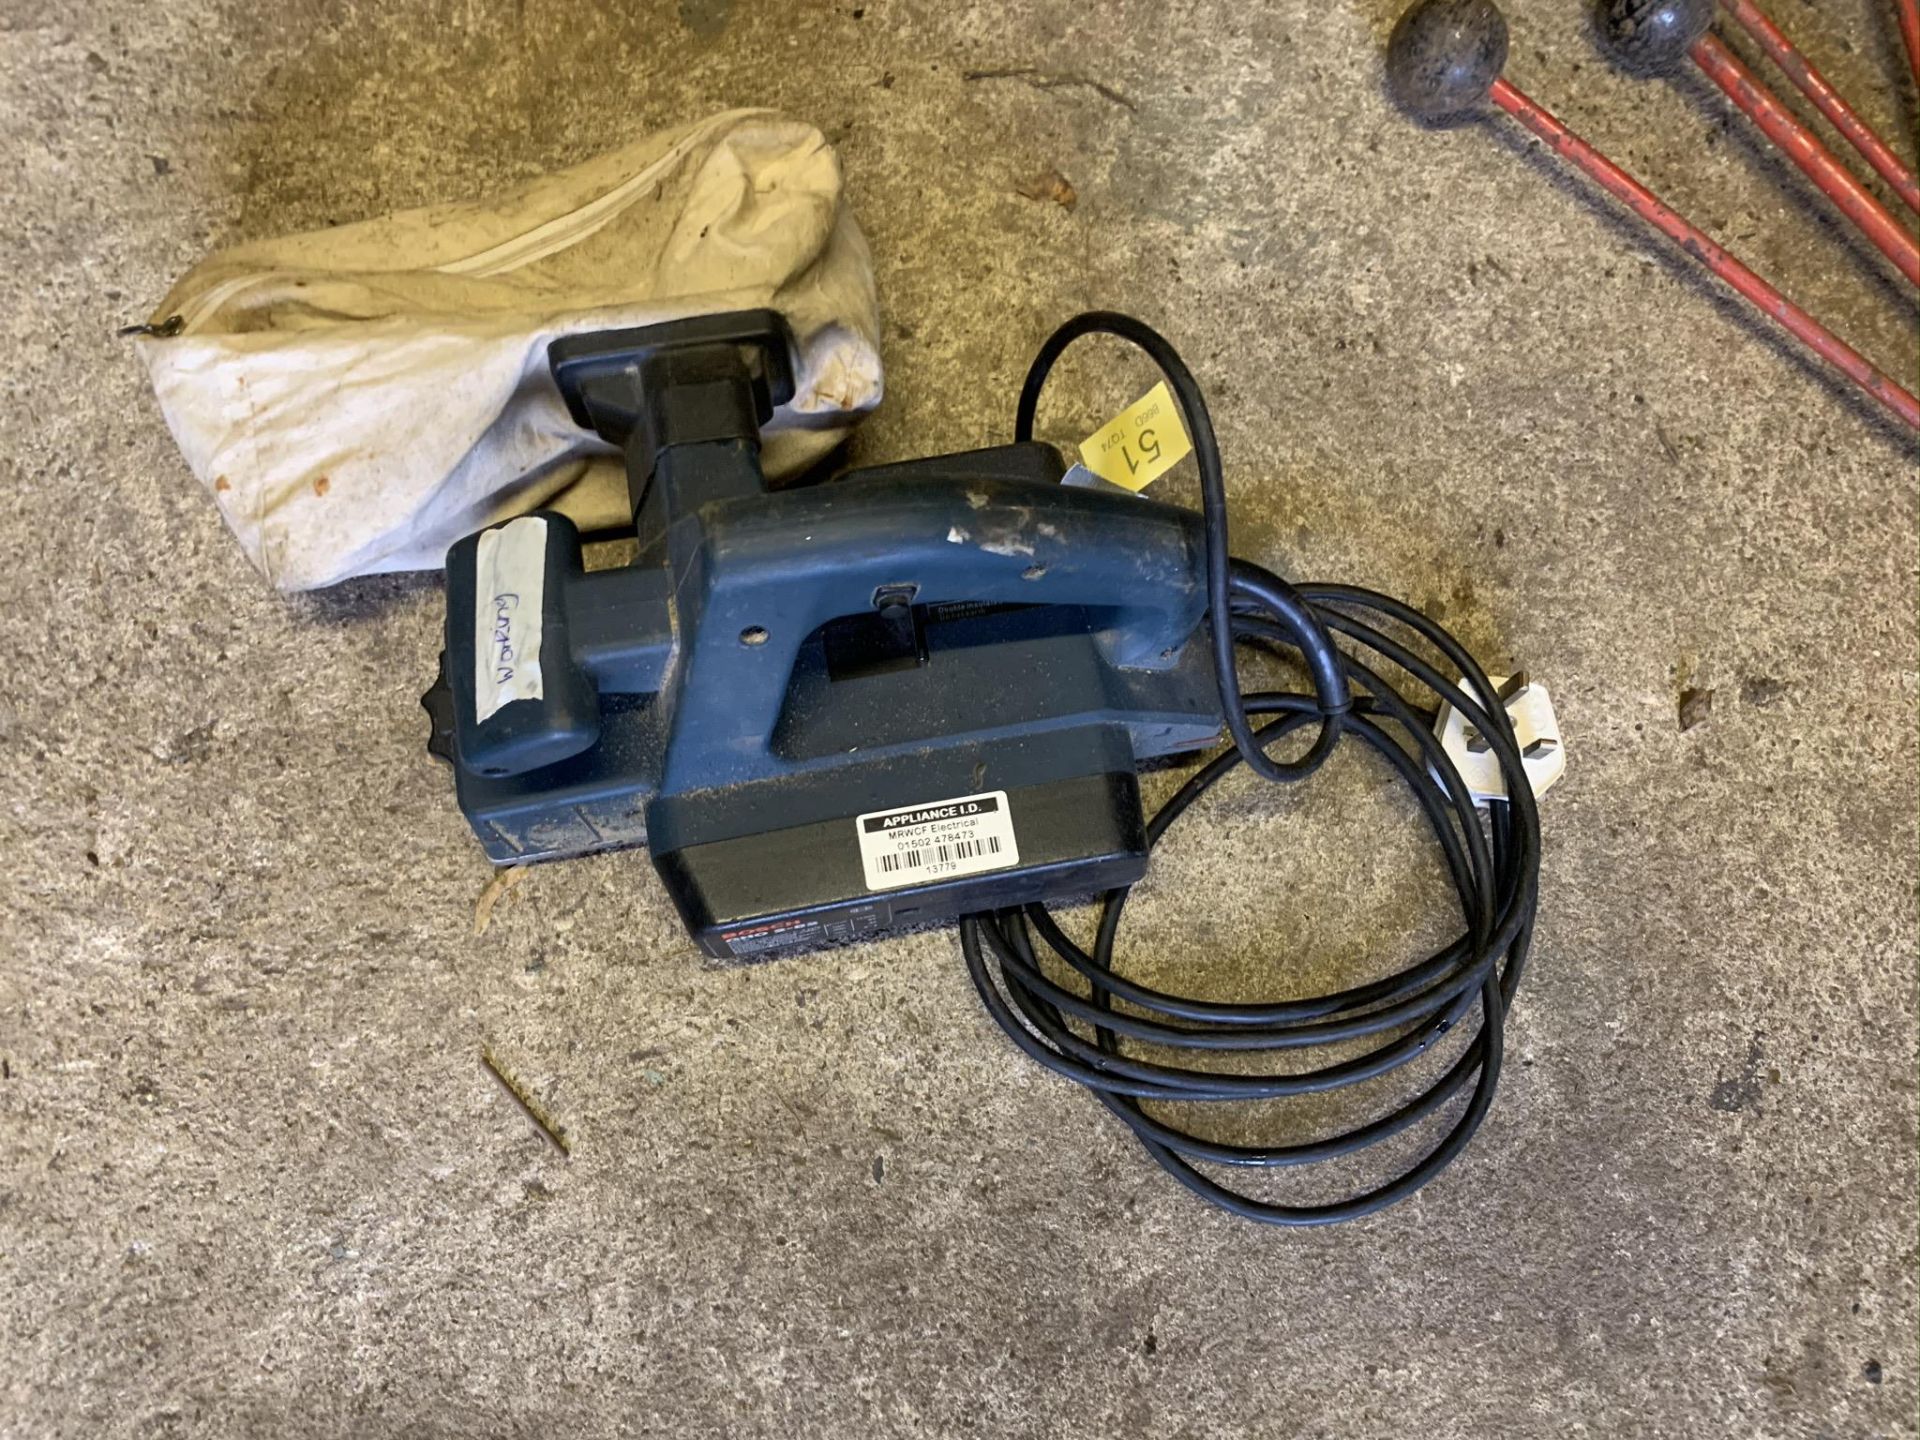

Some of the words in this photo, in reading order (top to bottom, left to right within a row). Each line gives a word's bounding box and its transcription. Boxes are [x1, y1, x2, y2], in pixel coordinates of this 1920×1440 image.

[1121, 428, 1161, 475] 51
[494, 593, 519, 684] Working
[883, 807, 957, 828] APPLIANCE
[959, 803, 982, 815] I.D.
[888, 827, 927, 840] MRWCF
[931, 818, 979, 833] Electrical
[897, 837, 931, 850] 01502
[934, 830, 975, 844] 478473
[926, 862, 957, 875] 13779
